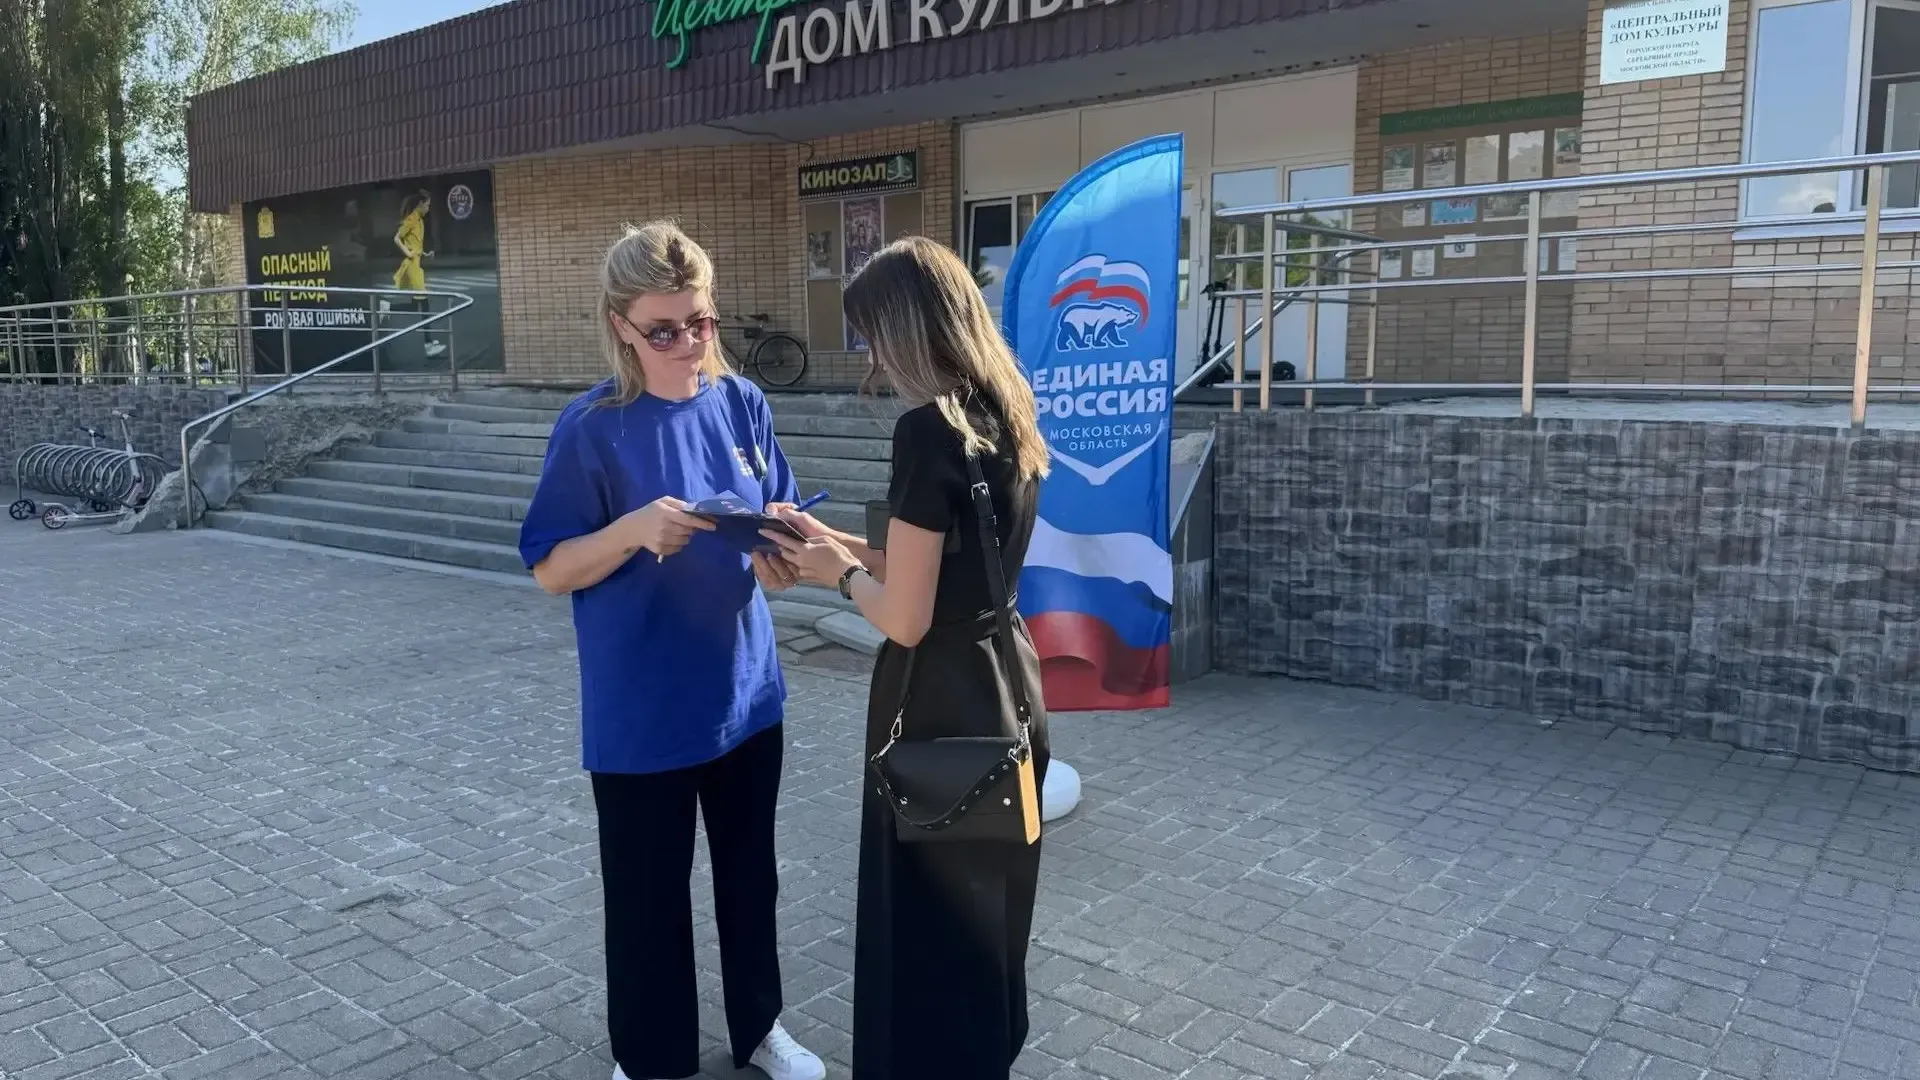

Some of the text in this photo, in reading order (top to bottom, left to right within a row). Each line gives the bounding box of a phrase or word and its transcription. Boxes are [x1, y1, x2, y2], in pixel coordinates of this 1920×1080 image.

[766, 0, 889, 89] ДОМ
[1609, 20, 1719, 44] ДОМ КУЛЬТУРЫ
[800, 162, 888, 190] КИНОЗАЛ
[261, 245, 331, 276] ОПАСНЫЙ
[316, 307, 366, 327] ОШИБКА
[1032, 358, 1168, 393] ЕДИНАЯ
[1035, 387, 1167, 420] РОССИЯ
[1050, 423, 1152, 441] МОСКОВСКАЯ
[1069, 439, 1128, 451] ОБЛАСТЬ
